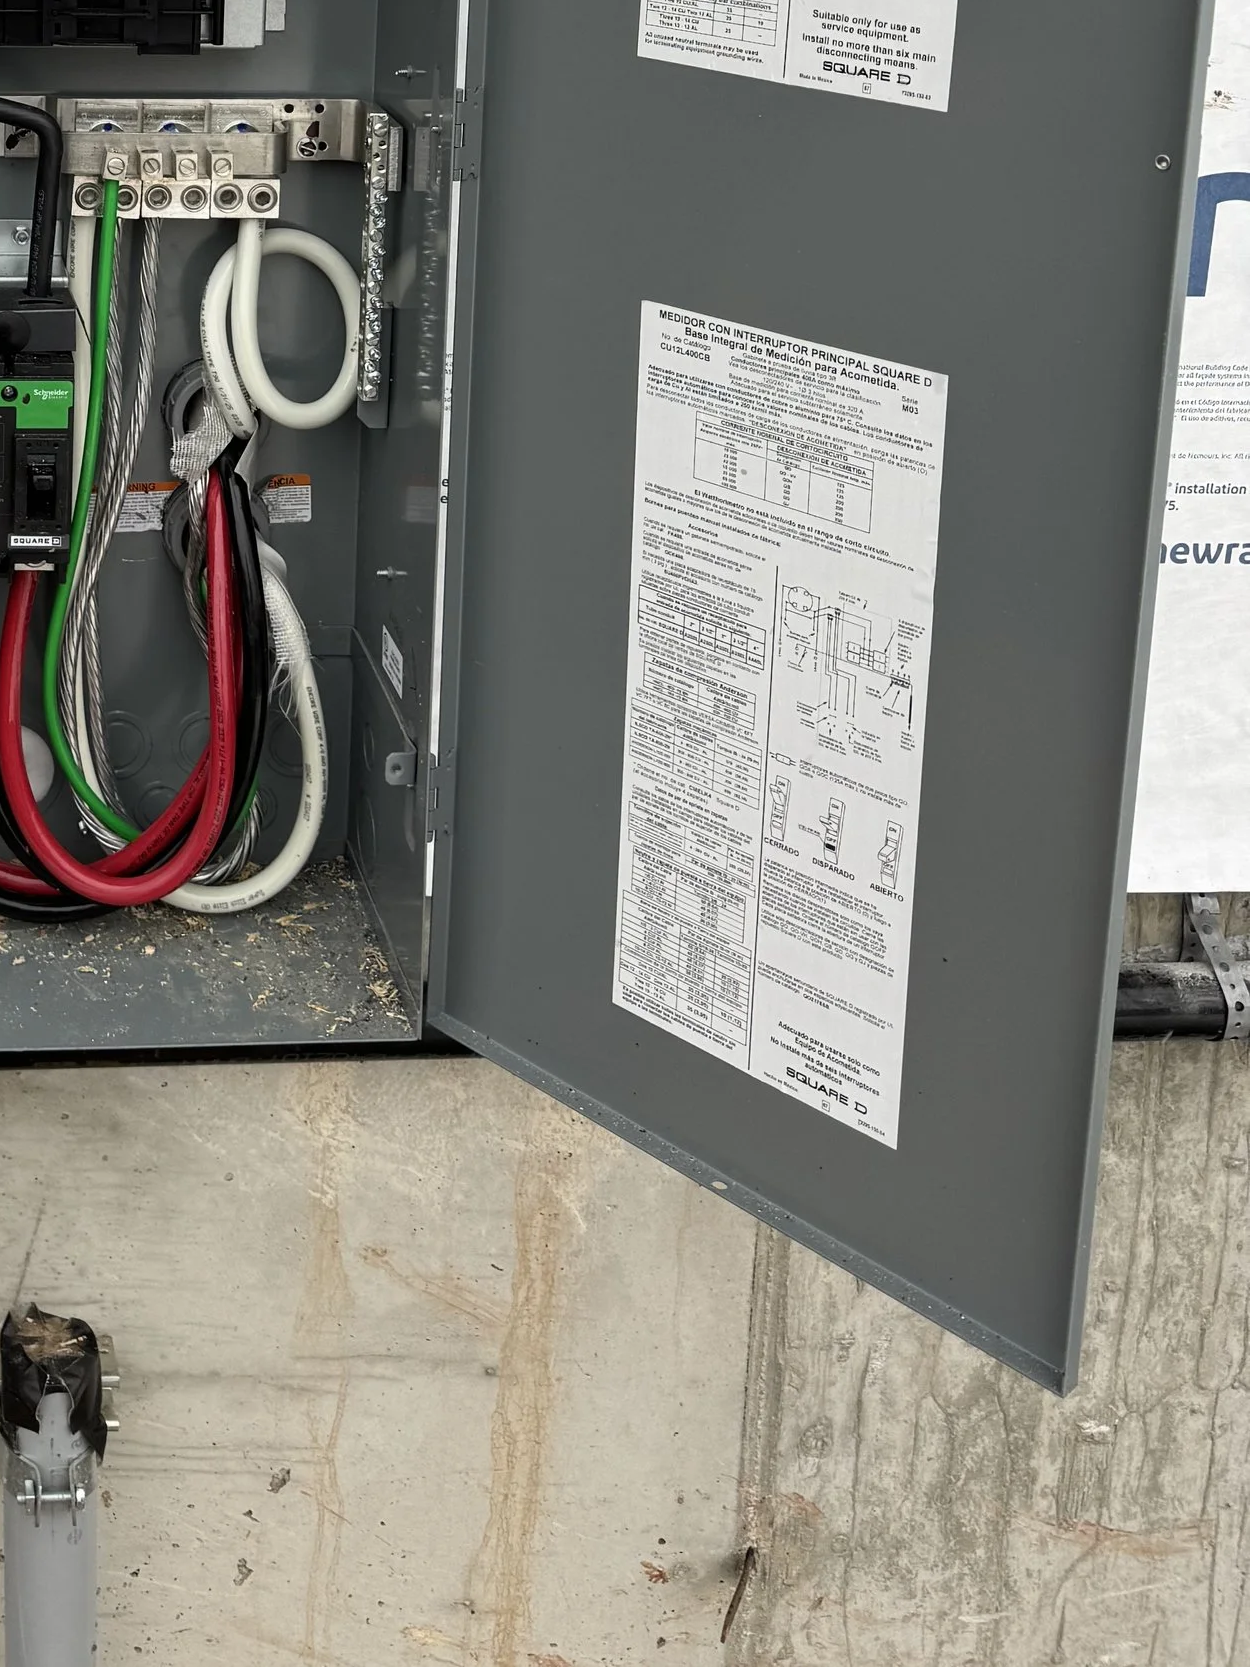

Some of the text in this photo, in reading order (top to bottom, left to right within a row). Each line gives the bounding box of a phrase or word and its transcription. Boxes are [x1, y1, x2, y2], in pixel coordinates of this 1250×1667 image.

[812, 9, 921, 34] Suitable only for use as
[821, 21, 909, 43] service equipment.
[802, 33, 936, 63] Install no more than six main
[816, 46, 882, 66] disconnecting
[822, 60, 891, 82] SQUARE
[896, 73, 911, 85] D
[659, 309, 932, 387] MEDIDOR CON INTERRUPTOR PRINCIPAL SQUARE D
[660, 342, 711, 362] CU12L400CB
[685, 327, 900, 391] Base Integral de Medición para Acometida.
[33, 388, 69, 397] Schneider
[901, 404, 919, 415] M03
[1174, 482, 1247, 495] installation
[763, 836, 800, 857] CERRADO
[812, 857, 855, 881] DISPARADO
[869, 883, 904, 902] ABIERTO
[786, 1066, 849, 1106] SQUARE
[854, 1101, 868, 1115] D
